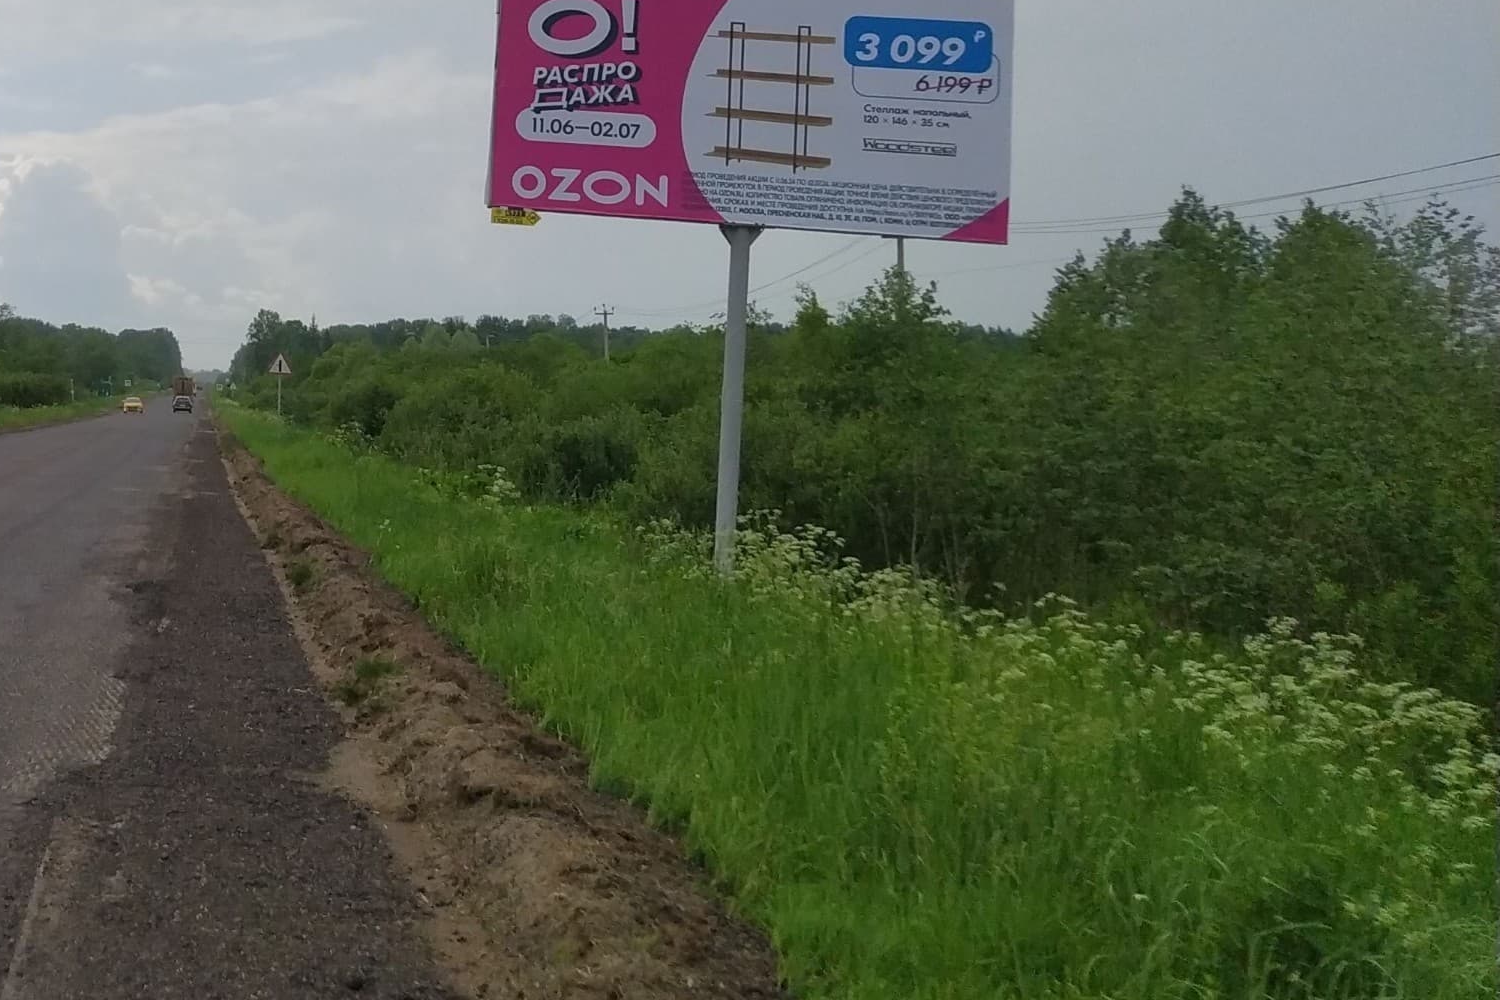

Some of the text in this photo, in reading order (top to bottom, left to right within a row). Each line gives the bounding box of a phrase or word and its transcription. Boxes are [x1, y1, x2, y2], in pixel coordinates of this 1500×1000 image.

[855, 33, 880, 61] 3
[890, 34, 966, 65] 099
[533, 61, 637, 85] РАСПРО
[915, 75, 930, 91] 6
[936, 76, 971, 94] 199
[530, 84, 635, 109] ДАЖА
[864, 104, 909, 115] Стеллаж
[864, 115, 879, 124] 120
[921, 118, 933, 127] 35
[512, 165, 669, 208] OZON
